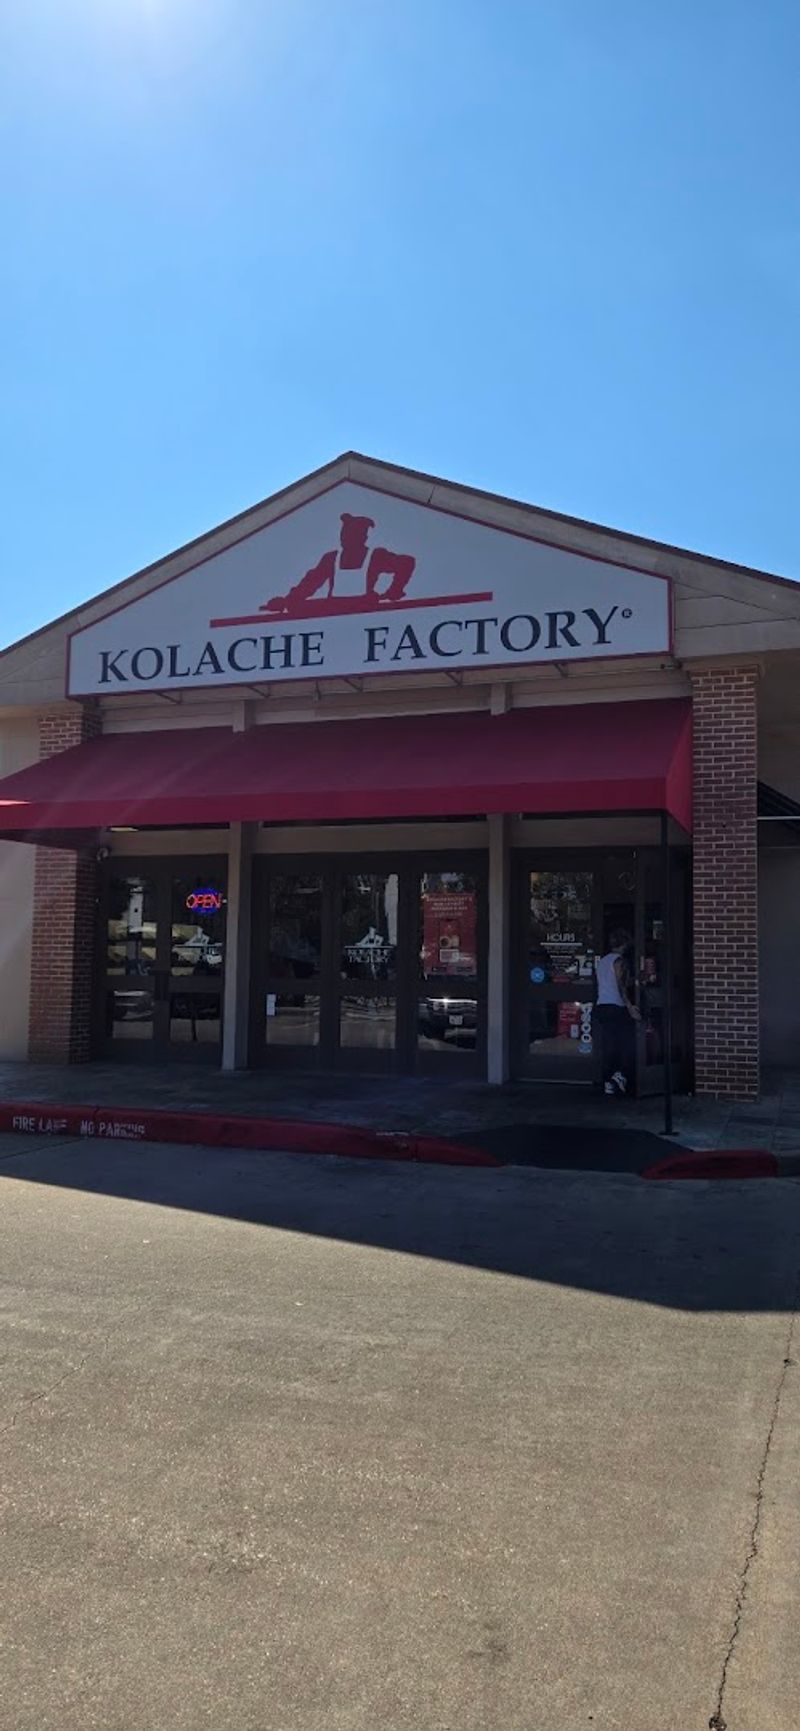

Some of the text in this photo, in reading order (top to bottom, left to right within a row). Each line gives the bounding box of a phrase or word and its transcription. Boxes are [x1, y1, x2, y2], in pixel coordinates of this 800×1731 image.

[98, 631, 325, 684] KOLACHE
[186, 893, 221, 909] OPEN
[546, 933, 576, 942] HOURS
[12, 1115, 36, 1132] FIRE
[80, 1119, 94, 1135] NO
